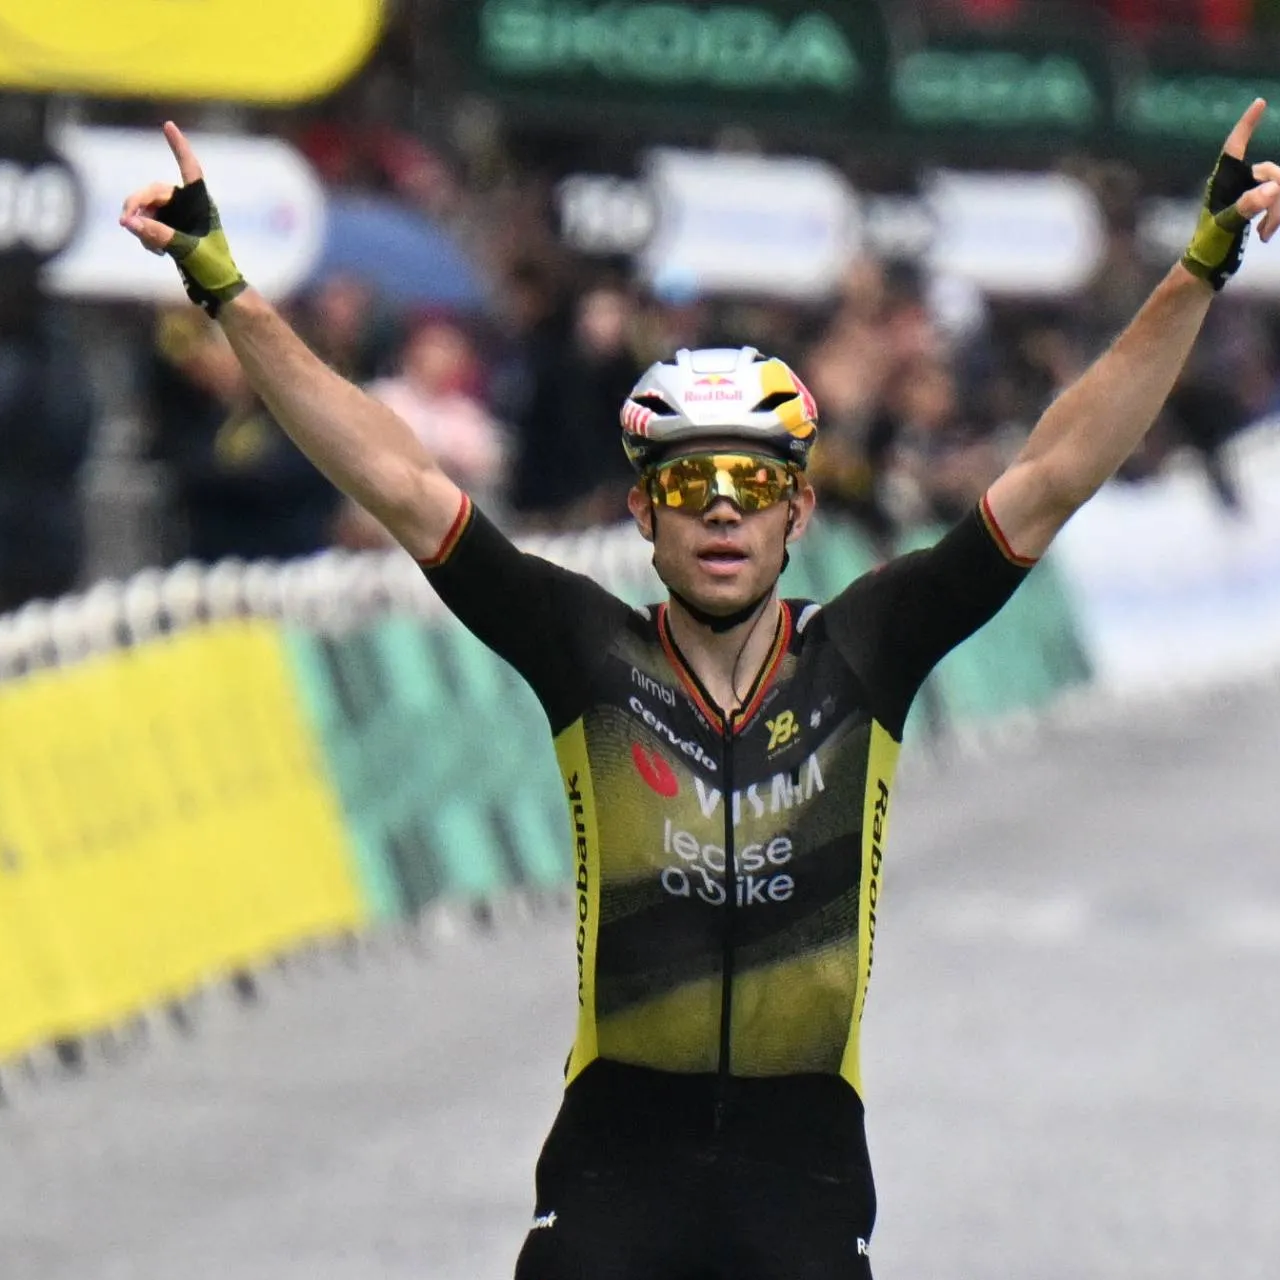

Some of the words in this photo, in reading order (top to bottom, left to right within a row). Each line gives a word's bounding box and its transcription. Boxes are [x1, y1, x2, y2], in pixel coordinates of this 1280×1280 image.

[684, 389, 713, 403] Red
[715, 389, 743, 402] Bull
[630, 666, 677, 708] nimbl
[628, 696, 718, 772] cervélo
[693, 752, 826, 829] VISMA
[663, 815, 794, 875] lease
